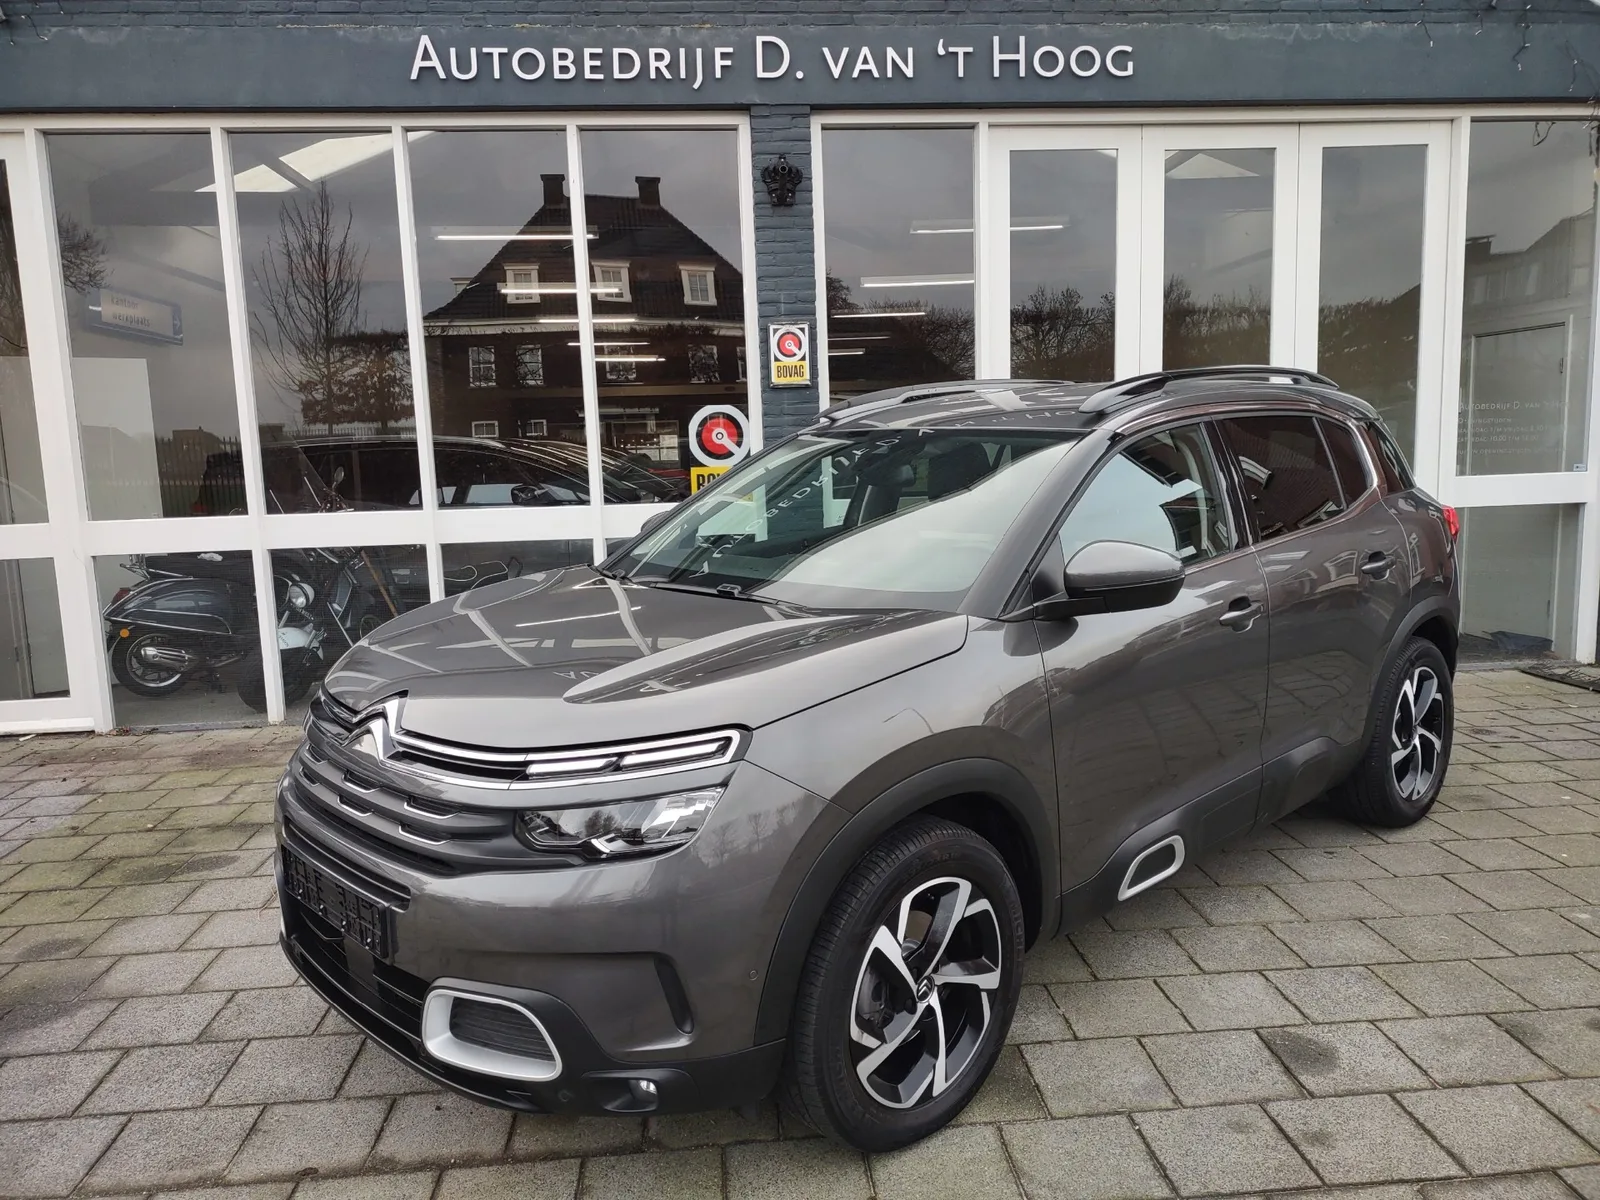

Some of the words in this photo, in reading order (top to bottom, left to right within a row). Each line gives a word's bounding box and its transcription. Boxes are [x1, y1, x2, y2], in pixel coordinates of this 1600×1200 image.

[410, 34, 734, 90] AUTOBEDRIJF
[754, 35, 805, 80] D.
[822, 44, 914, 79] VAN
[992, 35, 1135, 79] HOOG
[776, 365, 805, 379] BOVAG
